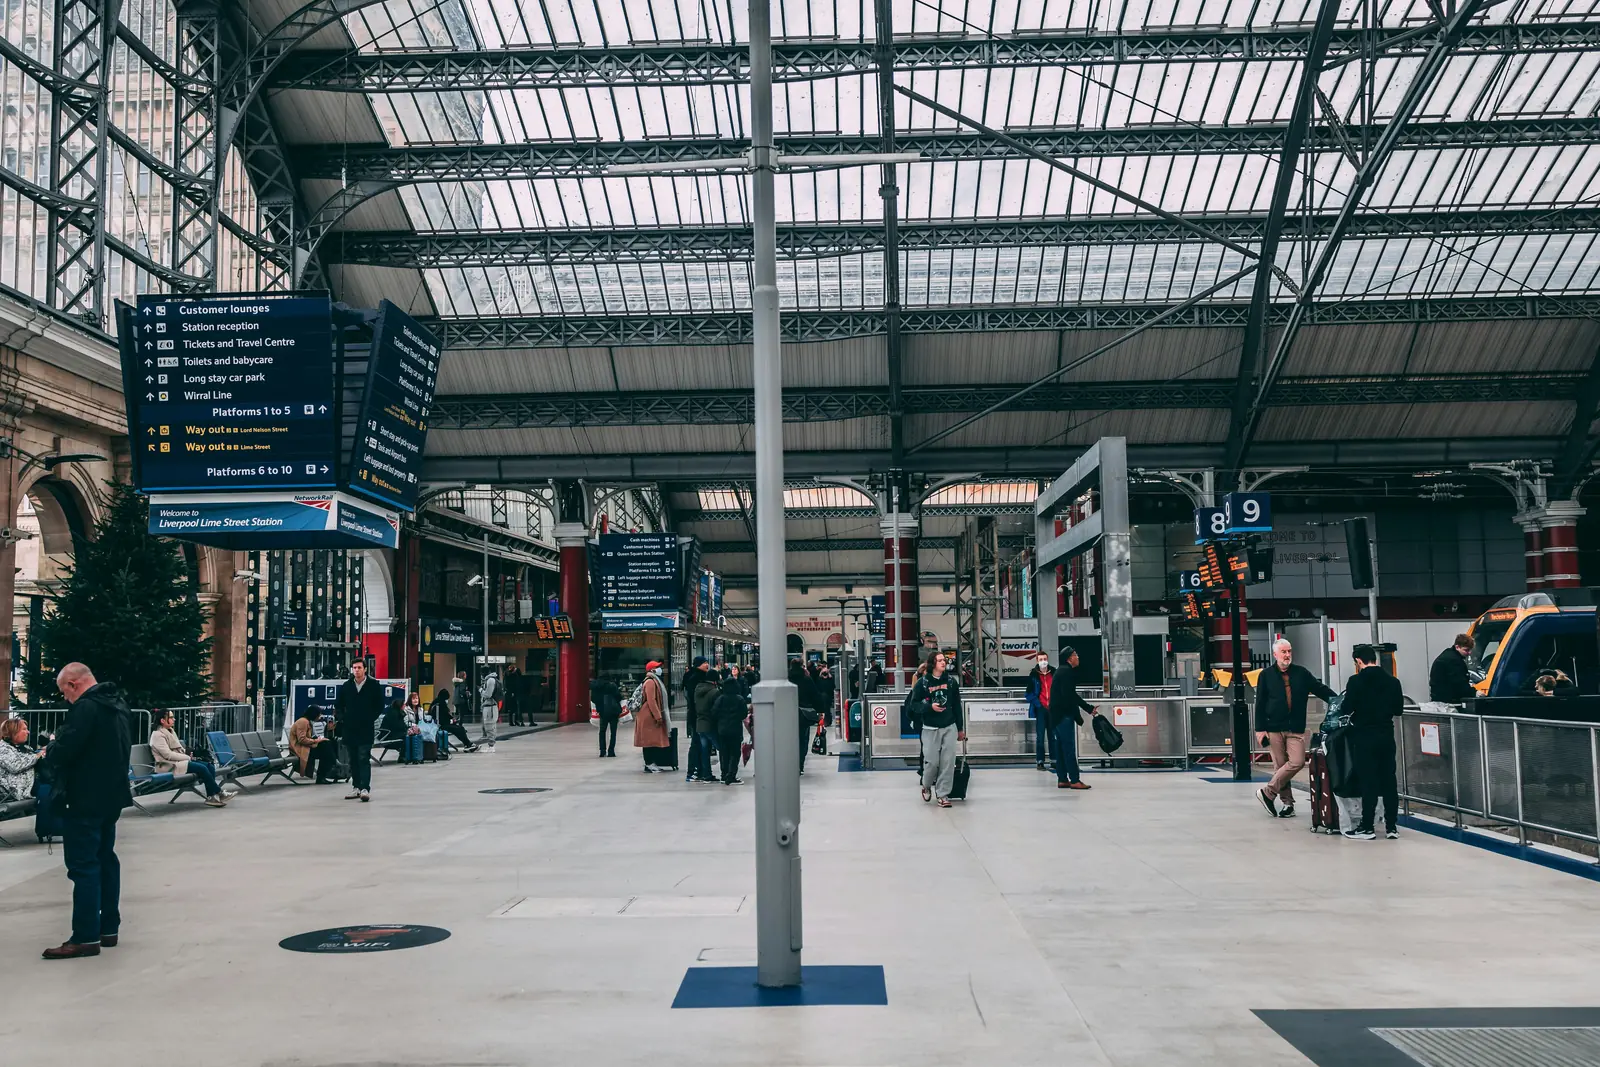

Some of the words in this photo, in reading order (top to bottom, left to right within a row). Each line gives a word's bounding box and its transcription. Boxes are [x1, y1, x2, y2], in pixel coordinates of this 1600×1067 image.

[179, 306, 228, 315] Customer
[230, 304, 270, 314] lounges
[182, 323, 214, 332] Station
[216, 322, 259, 332] reception
[182, 340, 216, 349] Tickets
[217, 339, 234, 348] and
[236, 338, 262, 347] Travel
[264, 338, 295, 347] Centre
[182, 357, 212, 366] Toilets
[213, 357, 230, 365] and
[232, 356, 273, 366] babycare
[184, 374, 206, 384] Long
[208, 374, 226, 384] stay
[245, 373, 265, 383] park
[184, 391, 211, 400] Wirral
[213, 391, 232, 399] Line
[212, 407, 261, 417] Platforms
[264, 406, 268, 415] 1
[271, 407, 282, 415] to
[284, 406, 291, 415] 5
[186, 425, 206, 434] Way
[208, 426, 225, 434] out
[186, 443, 206, 452] Way
[208, 443, 225, 451] out
[207, 468, 256, 477] Platforms
[258, 466, 265, 475] 6
[268, 466, 279, 475] to
[280, 466, 292, 474] 10
[1225, 502, 1230, 524] 9
[1243, 500, 1260, 522] 9
[159, 519, 199, 529] Liverpool
[200, 519, 222, 527] Lime
[223, 518, 249, 527] Street
[251, 518, 283, 526] Station
[1195, 515, 1200, 536] 8
[1211, 513, 1225, 534] 8
[1300, 531, 1316, 541] TO
[1190, 573, 1200, 586] 6
